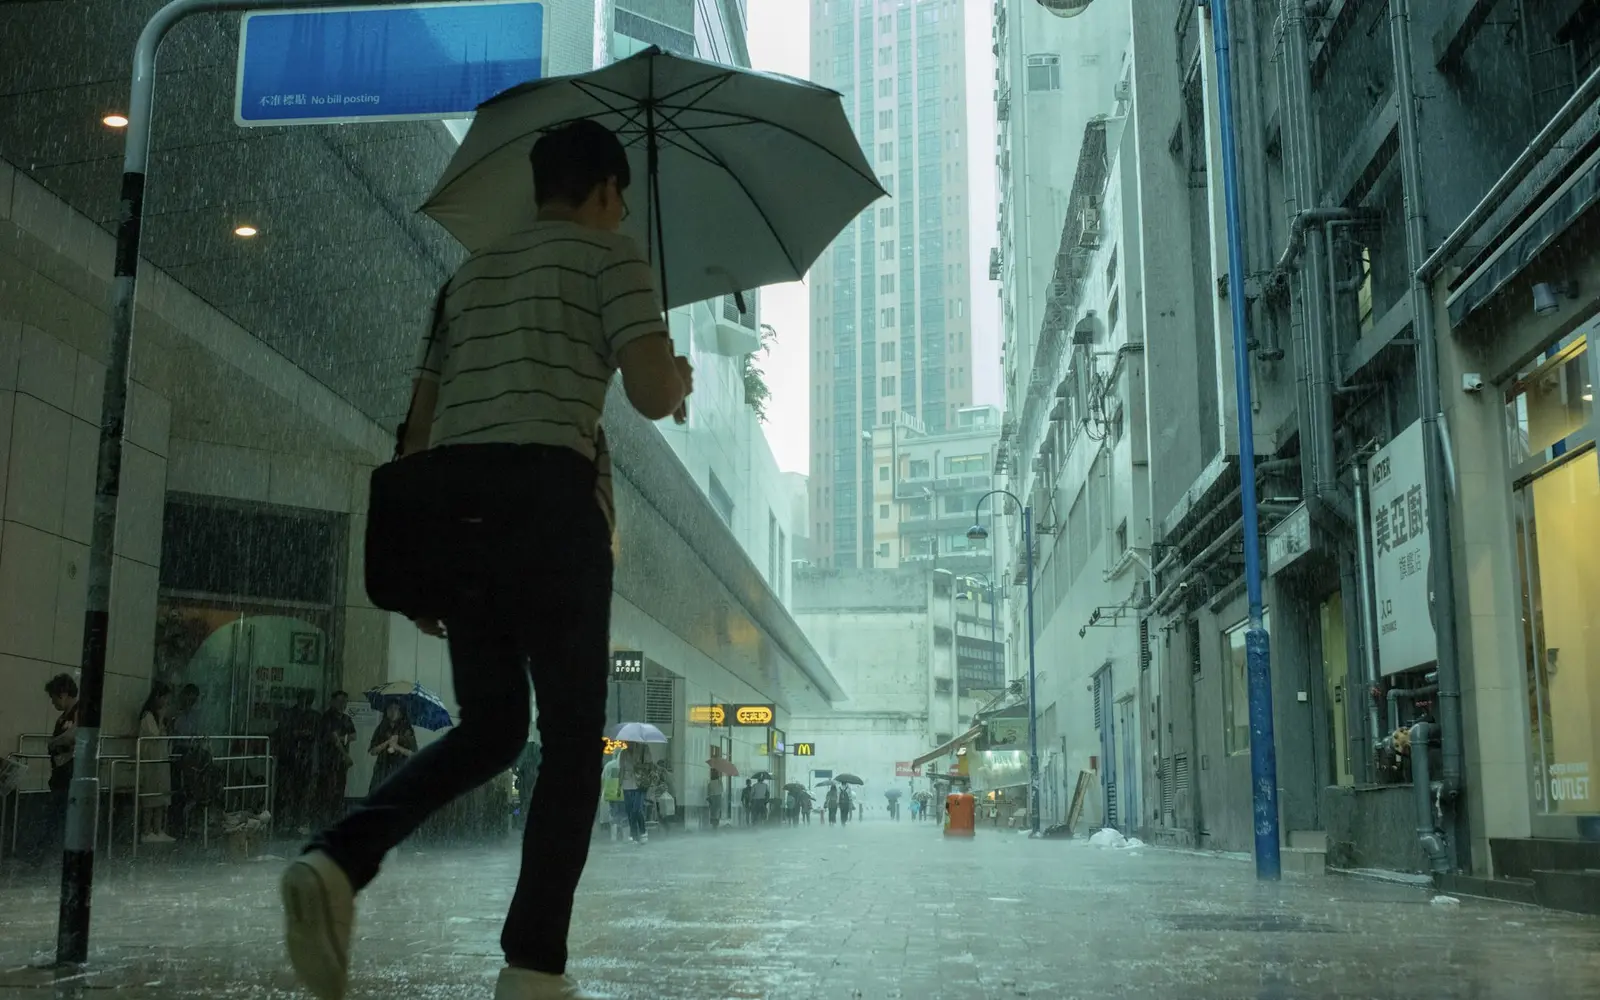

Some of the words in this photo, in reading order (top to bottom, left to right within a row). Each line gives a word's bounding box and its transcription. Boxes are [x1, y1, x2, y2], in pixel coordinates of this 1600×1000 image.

[260, 94, 306, 106] 不准標貼
[311, 96, 325, 105] No
[327, 94, 342, 104] bill
[344, 93, 380, 105] posting
[1372, 456, 1391, 487] MEYER
[1375, 483, 1429, 559] 美亞廚
[1381, 598, 1393, 620] 入口
[798, 743, 811, 755] M
[1551, 777, 1589, 801] OUTLET
